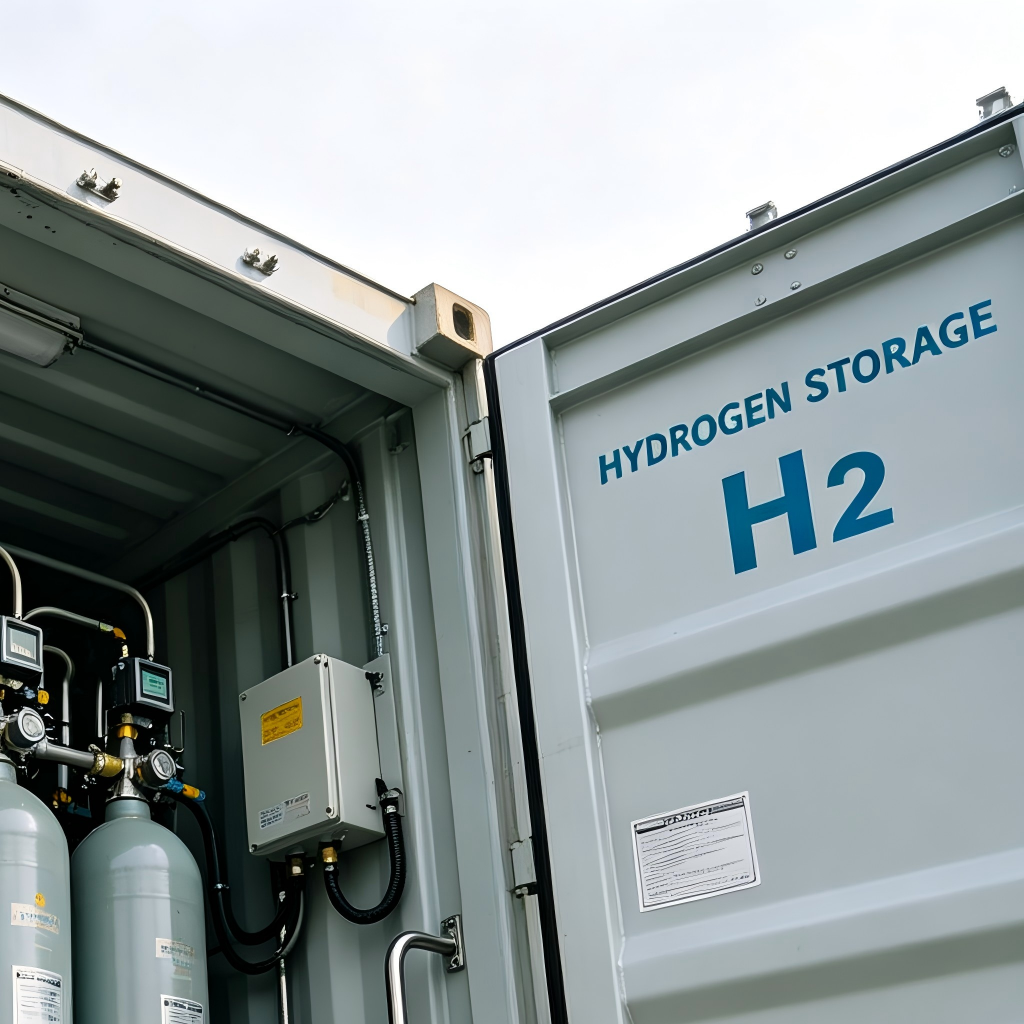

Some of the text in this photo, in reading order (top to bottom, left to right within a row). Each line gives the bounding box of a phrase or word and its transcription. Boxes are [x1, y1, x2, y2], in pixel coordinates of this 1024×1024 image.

[598, 299, 998, 485] HYDROGEN STORAGE
[721, 449, 894, 575] H2
